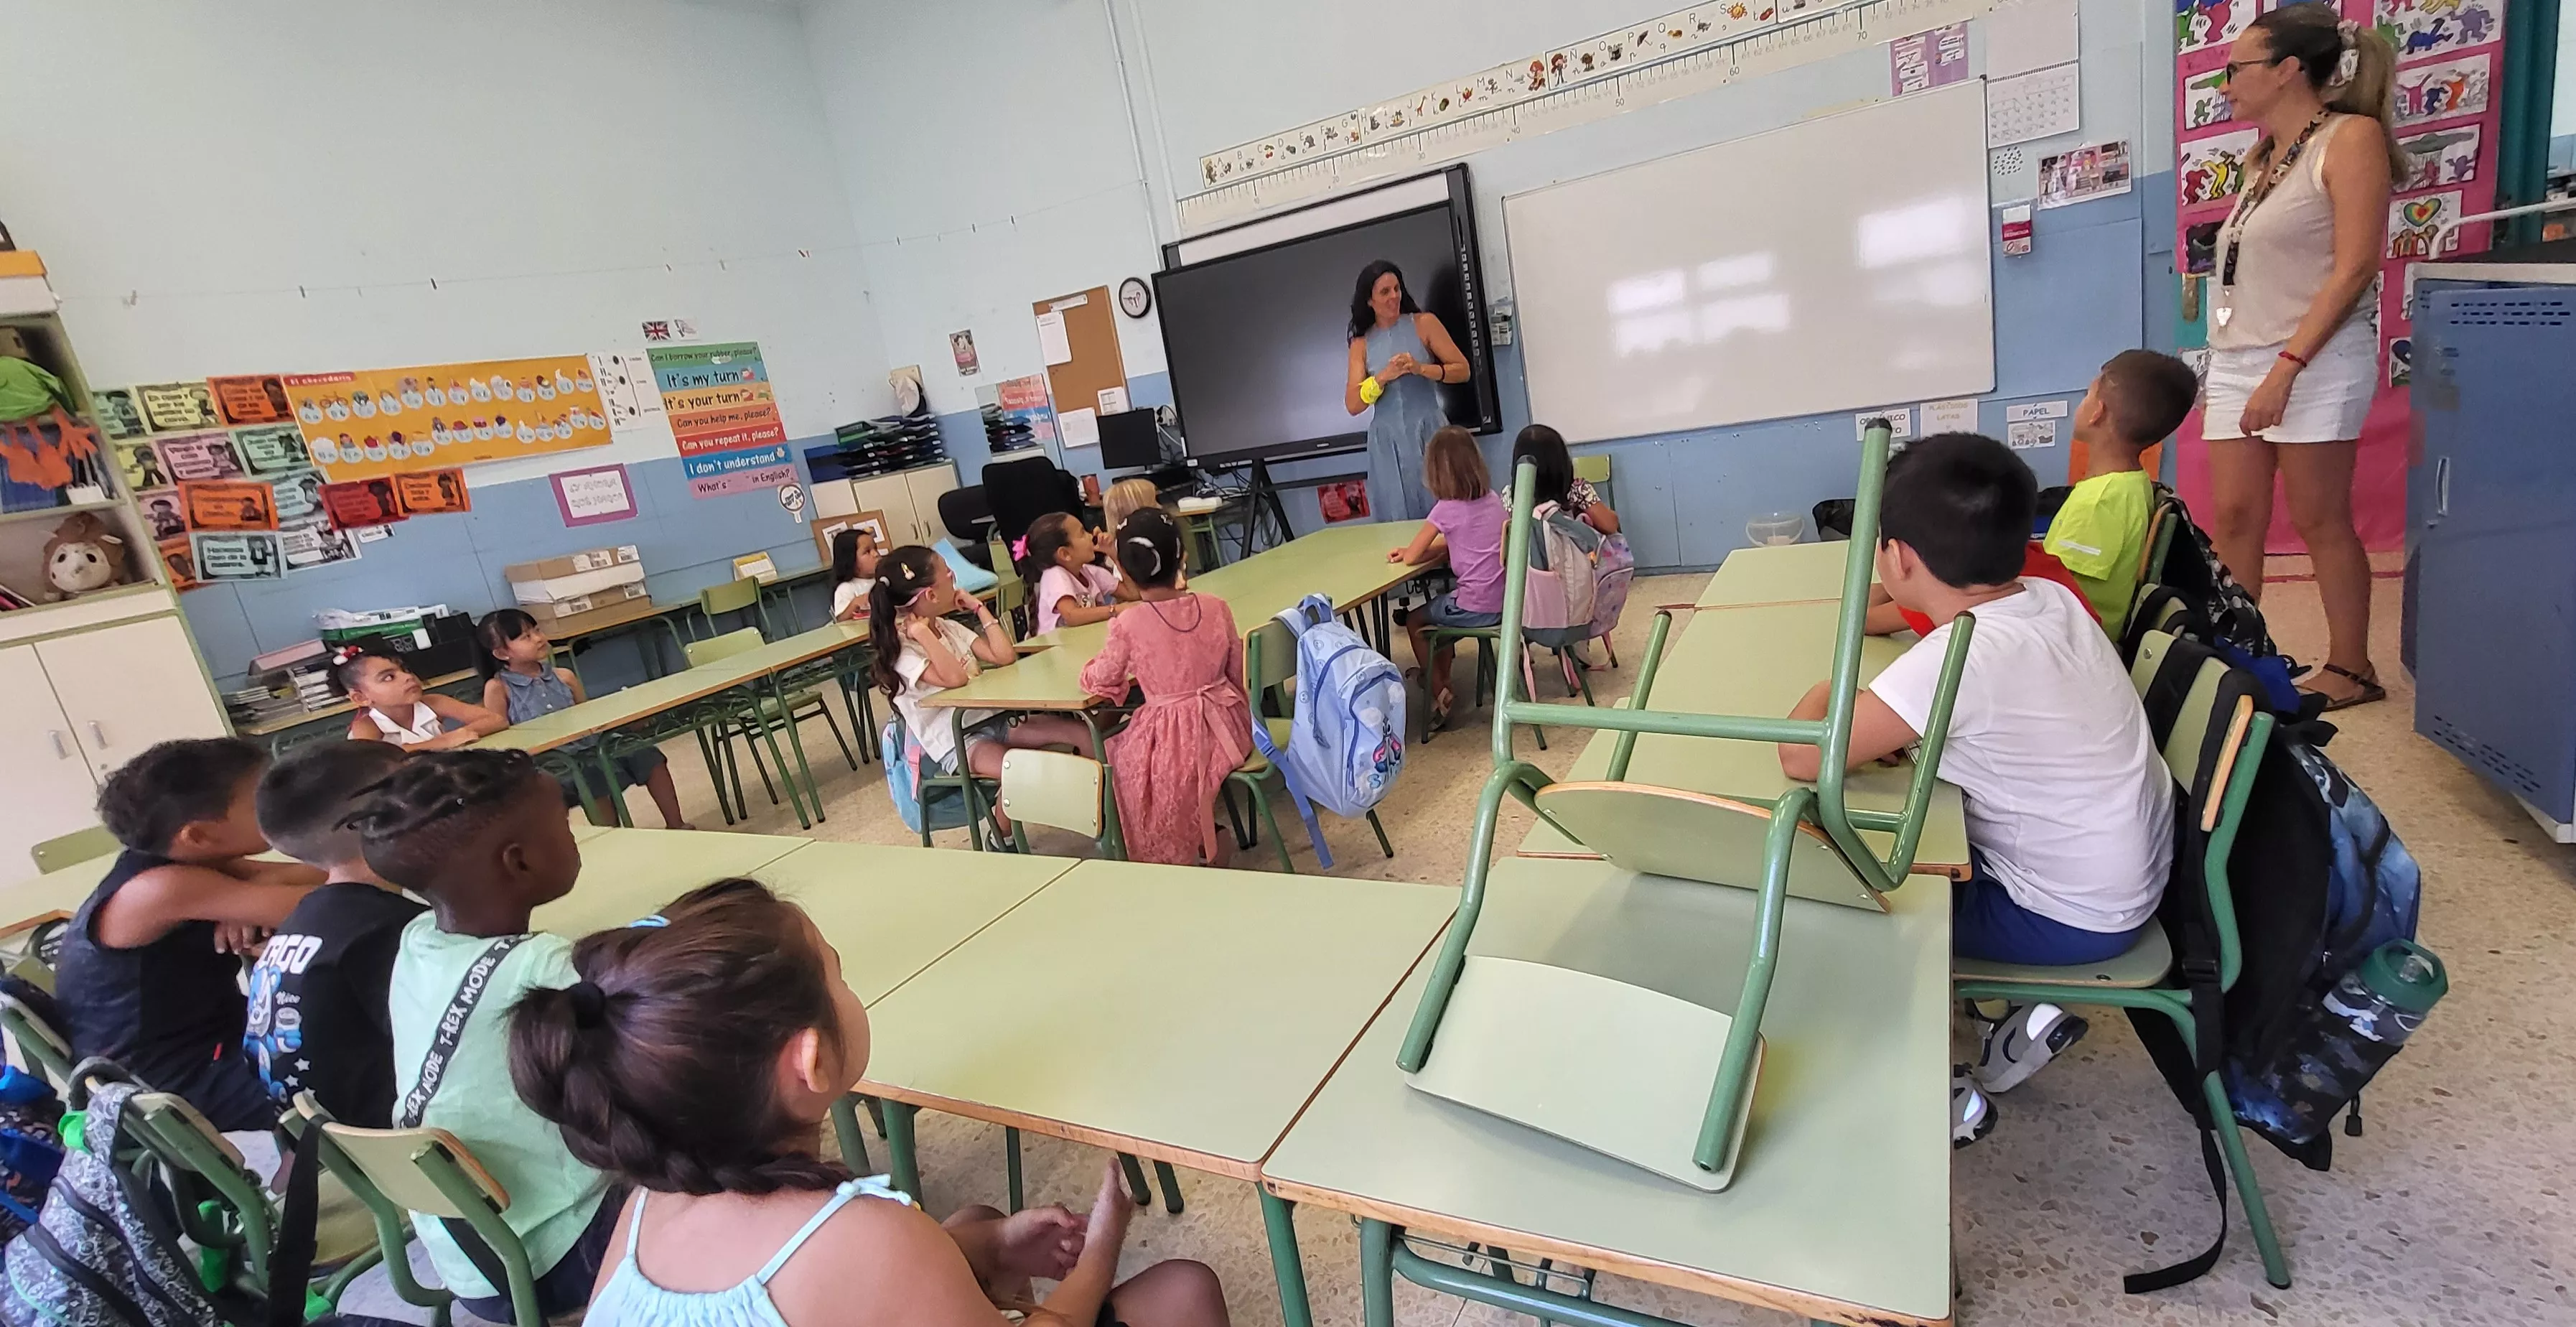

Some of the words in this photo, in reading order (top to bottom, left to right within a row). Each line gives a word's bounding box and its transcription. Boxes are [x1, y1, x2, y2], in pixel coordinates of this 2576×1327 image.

[1615, 98, 1624, 107] 50
[1730, 67, 1740, 76] 60
[1857, 31, 1867, 40] 70
[1237, 151, 1243, 159] B
[1258, 144, 1263, 153] C
[1278, 139, 1284, 147] D
[1299, 132, 1304, 141] E
[1361, 113, 1367, 121] H
[1408, 99, 1412, 108] J
[1431, 93, 1436, 101] K
[1456, 85, 1461, 94] L
[1477, 78, 1485, 87] M
[1599, 42, 1607, 51] O
[1628, 32, 1635, 43] P
[1689, 14, 1695, 24] R
[1720, 4, 1727, 14] S
[669, 352, 693, 362] borrow
[666, 373, 689, 388] It's
[692, 373, 709, 386] my
[714, 368, 739, 383] turn
[663, 396, 685, 411] It's
[688, 395, 714, 408] your
[717, 392, 740, 404] turn
[2022, 407, 2050, 416] PAPEL
[678, 418, 692, 427] Can
[694, 416, 709, 427] you
[711, 412, 727, 424] help
[729, 413, 742, 422] me,
[745, 408, 770, 420] please?
[682, 439, 698, 450] Can
[699, 438, 714, 448] you
[715, 434, 741, 447] repeat
[742, 432, 751, 442] it,
[752, 428, 778, 441] please?
[689, 463, 694, 475] I
[696, 459, 722, 472] don't
[724, 451, 775, 470] understand
[698, 480, 727, 492] What's
[752, 474, 759, 483] in
[760, 470, 790, 483] English?
[459, 956, 495, 1004] MODE
[421, 1051, 444, 1094] MODE
